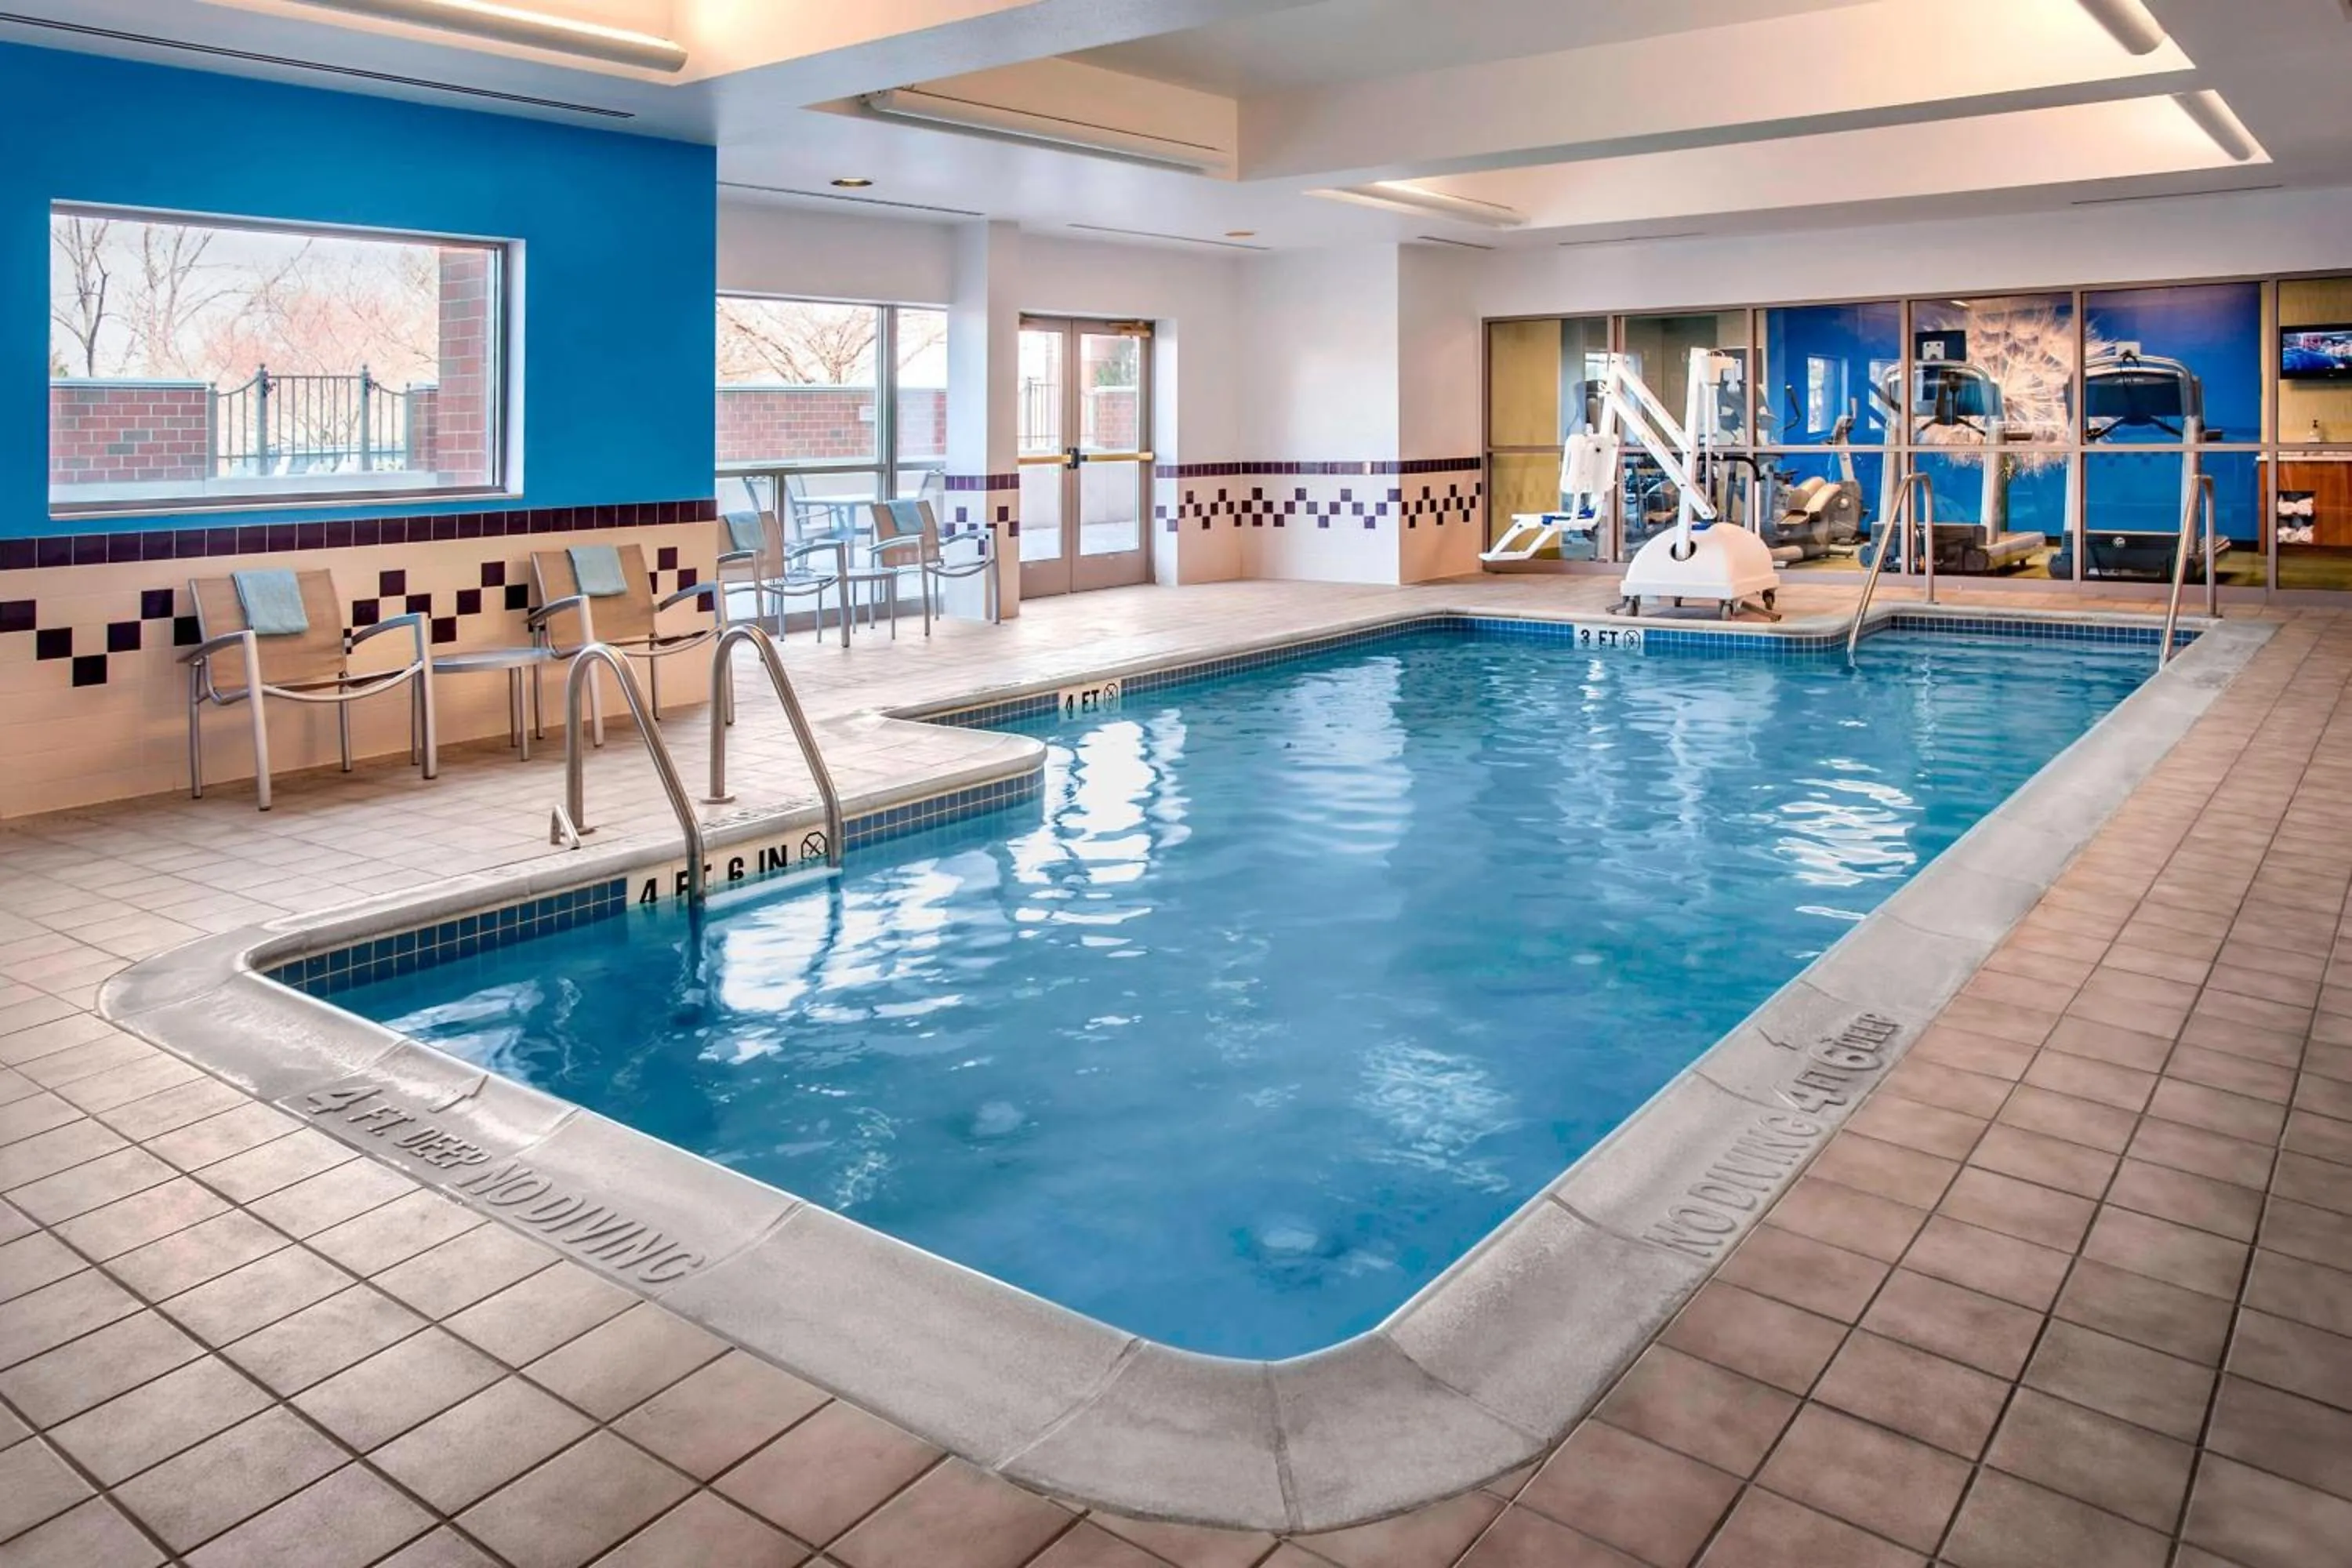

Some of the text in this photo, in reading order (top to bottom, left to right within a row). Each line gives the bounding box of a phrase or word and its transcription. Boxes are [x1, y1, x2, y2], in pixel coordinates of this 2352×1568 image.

[1581, 629, 1618, 646] 3 FT
[640, 878, 657, 903] 4
[728, 857, 744, 881] 6
[758, 844, 788, 873] IN
[307, 1088, 383, 1115] 4
[393, 1125, 491, 1169] DEEP
[456, 1161, 554, 1206] NO
[514, 1196, 703, 1283] DIVING
[1687, 1115, 1821, 1211] DIVING
[1642, 1204, 1737, 1258] NO
